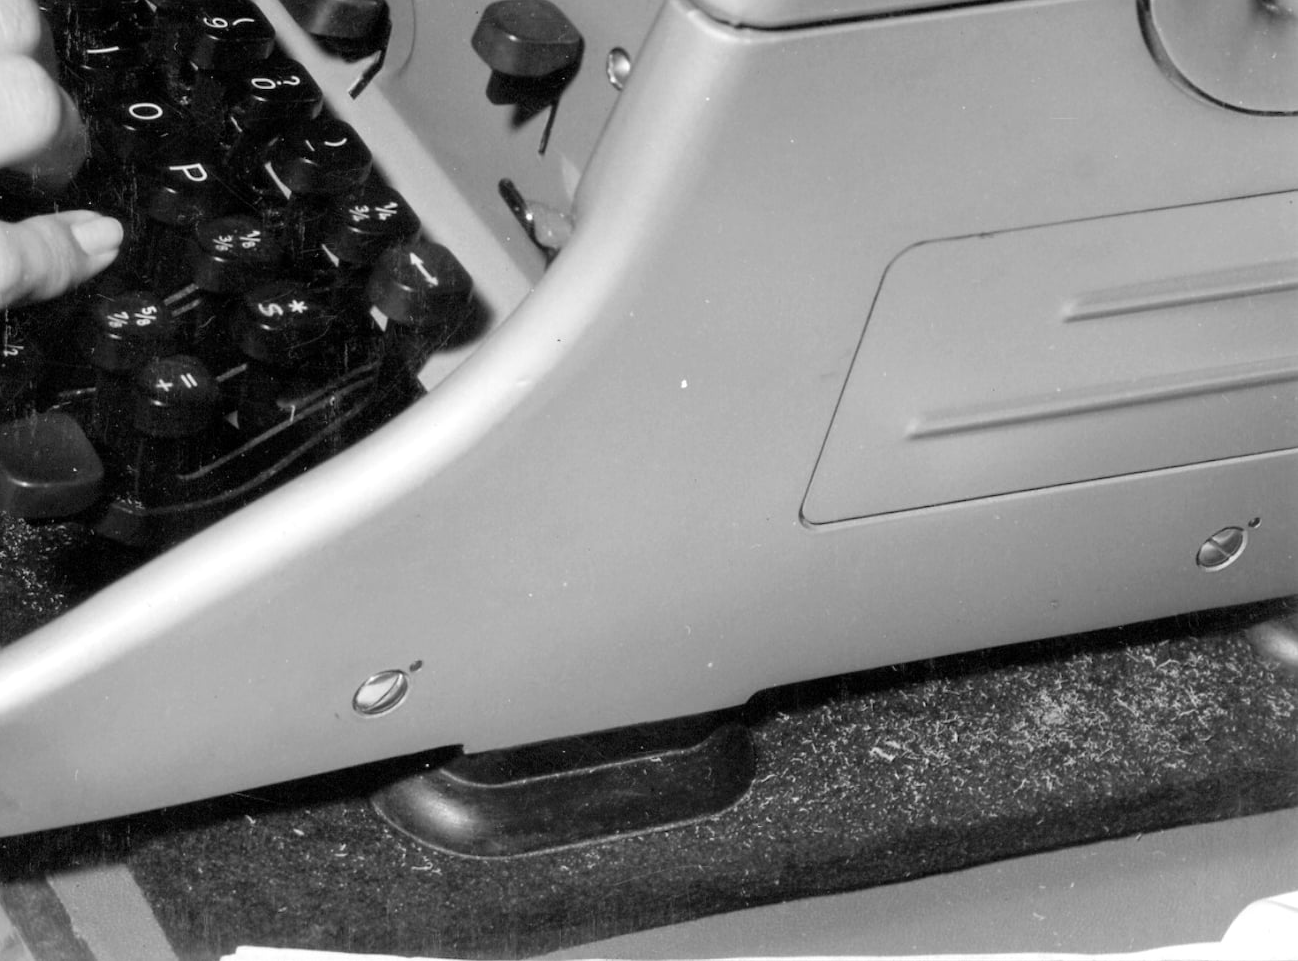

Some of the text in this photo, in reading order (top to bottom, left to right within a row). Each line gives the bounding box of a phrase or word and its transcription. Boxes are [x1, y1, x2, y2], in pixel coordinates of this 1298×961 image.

[202, 16, 229, 29] 9
[128, 101, 164, 121] O
[168, 162, 209, 182] P
